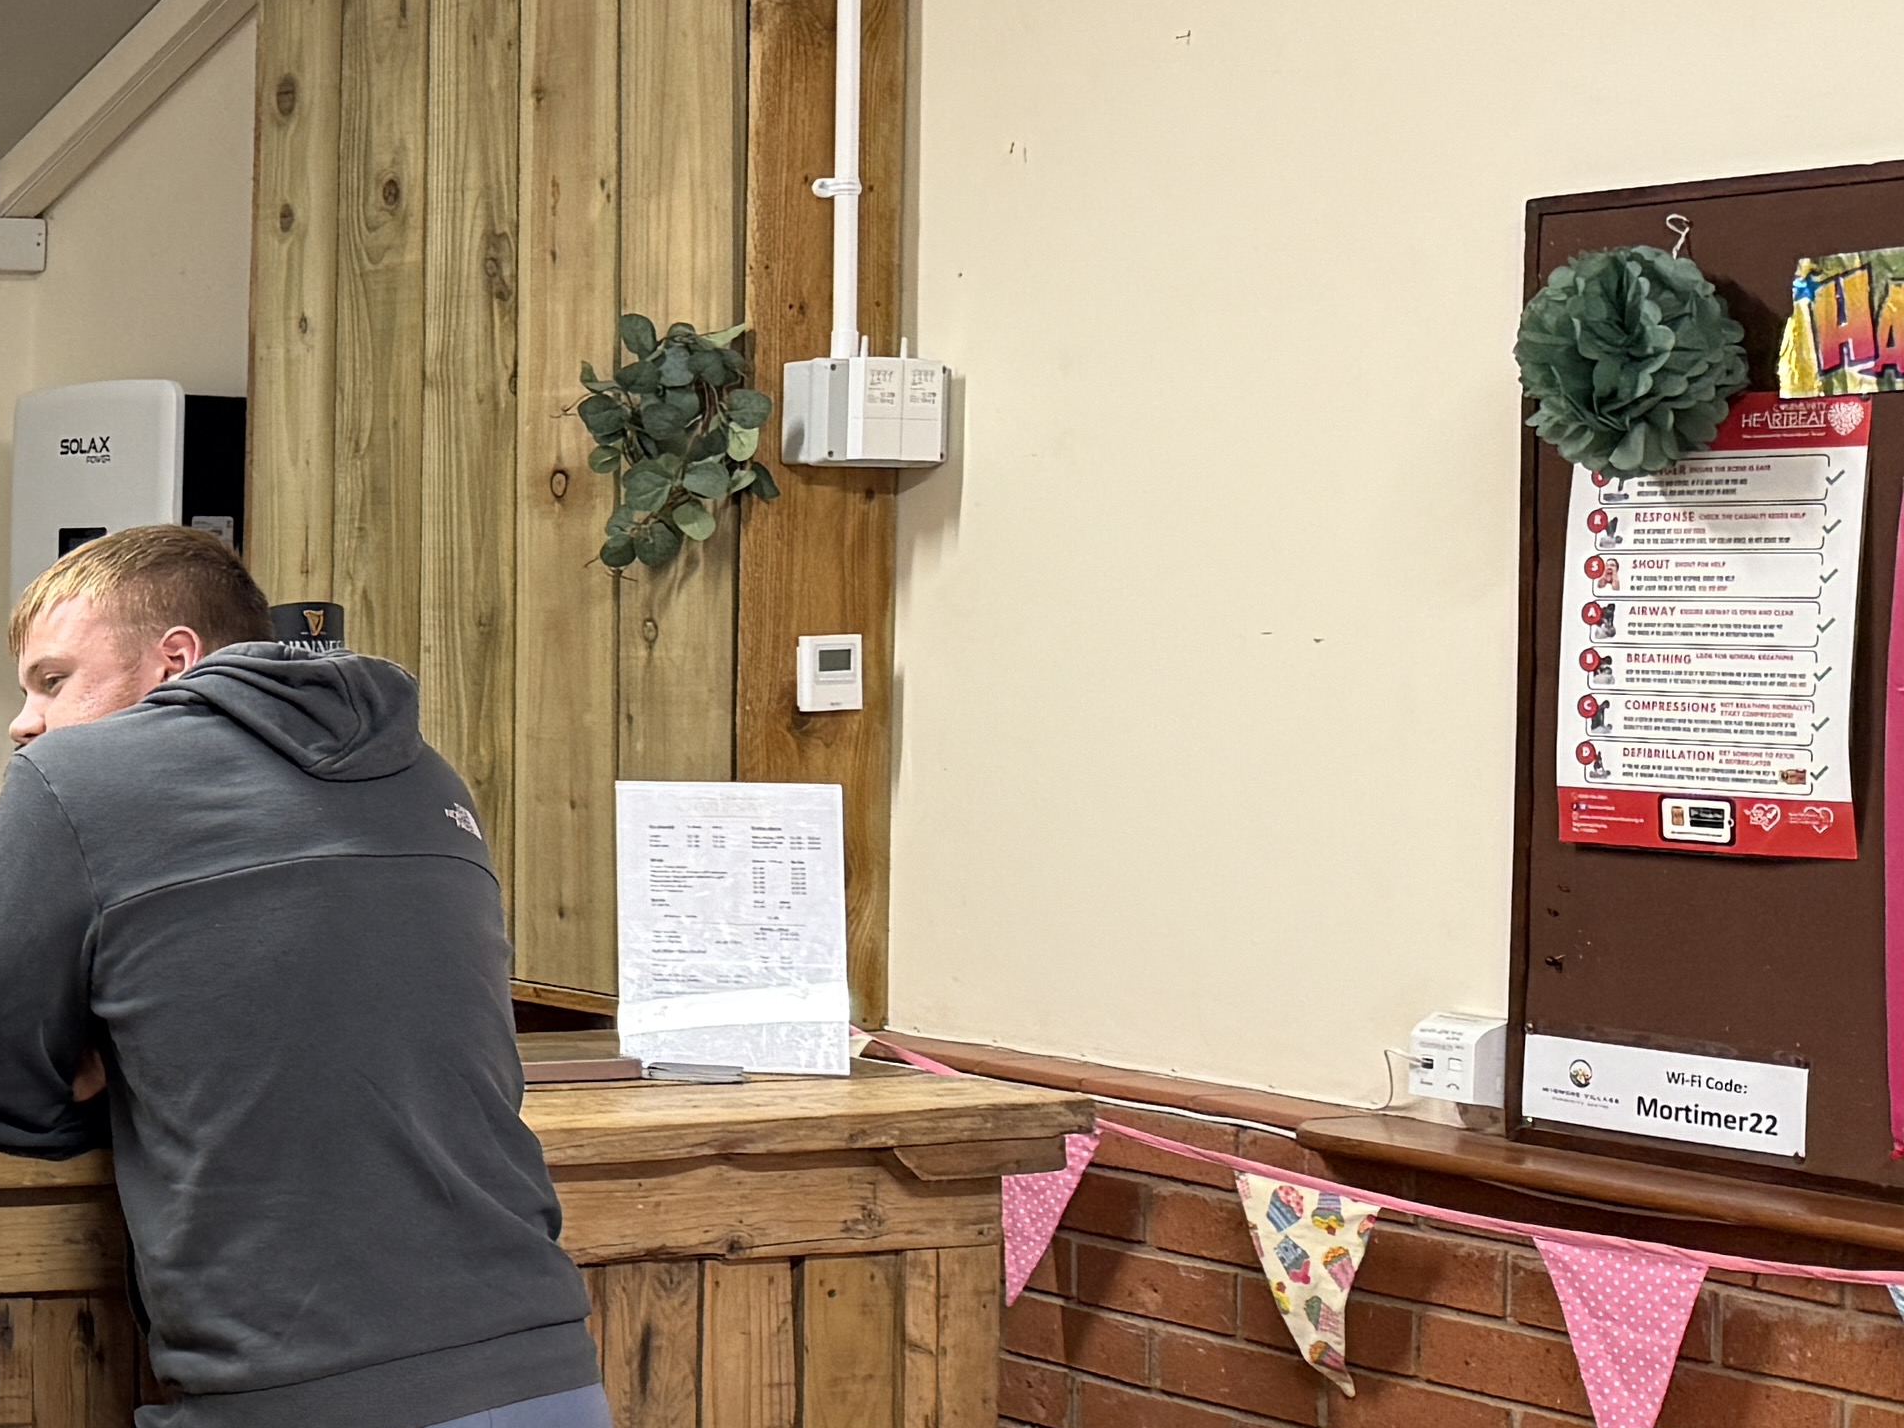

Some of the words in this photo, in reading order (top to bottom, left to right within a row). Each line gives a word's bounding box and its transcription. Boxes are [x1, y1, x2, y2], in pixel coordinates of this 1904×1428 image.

[1742, 411, 1826, 429] HEARTBEAT
[60, 436, 110, 455] SOLAX
[86, 455, 110, 464] POWER
[1635, 511, 1695, 522] RESPONSE
[1632, 559, 1670, 570] SHOUT
[1629, 606, 1676, 617] AIRWAY
[1626, 653, 1692, 665] BREATHING
[1624, 700, 1717, 714] COMPRESSIONS
[1622, 747, 1715, 761] DEFIBRILLATION
[1666, 1071, 1702, 1088] Wi-Fi
[1706, 1077, 1748, 1094] Code:
[1637, 1096, 1779, 1136] Mortimer22
